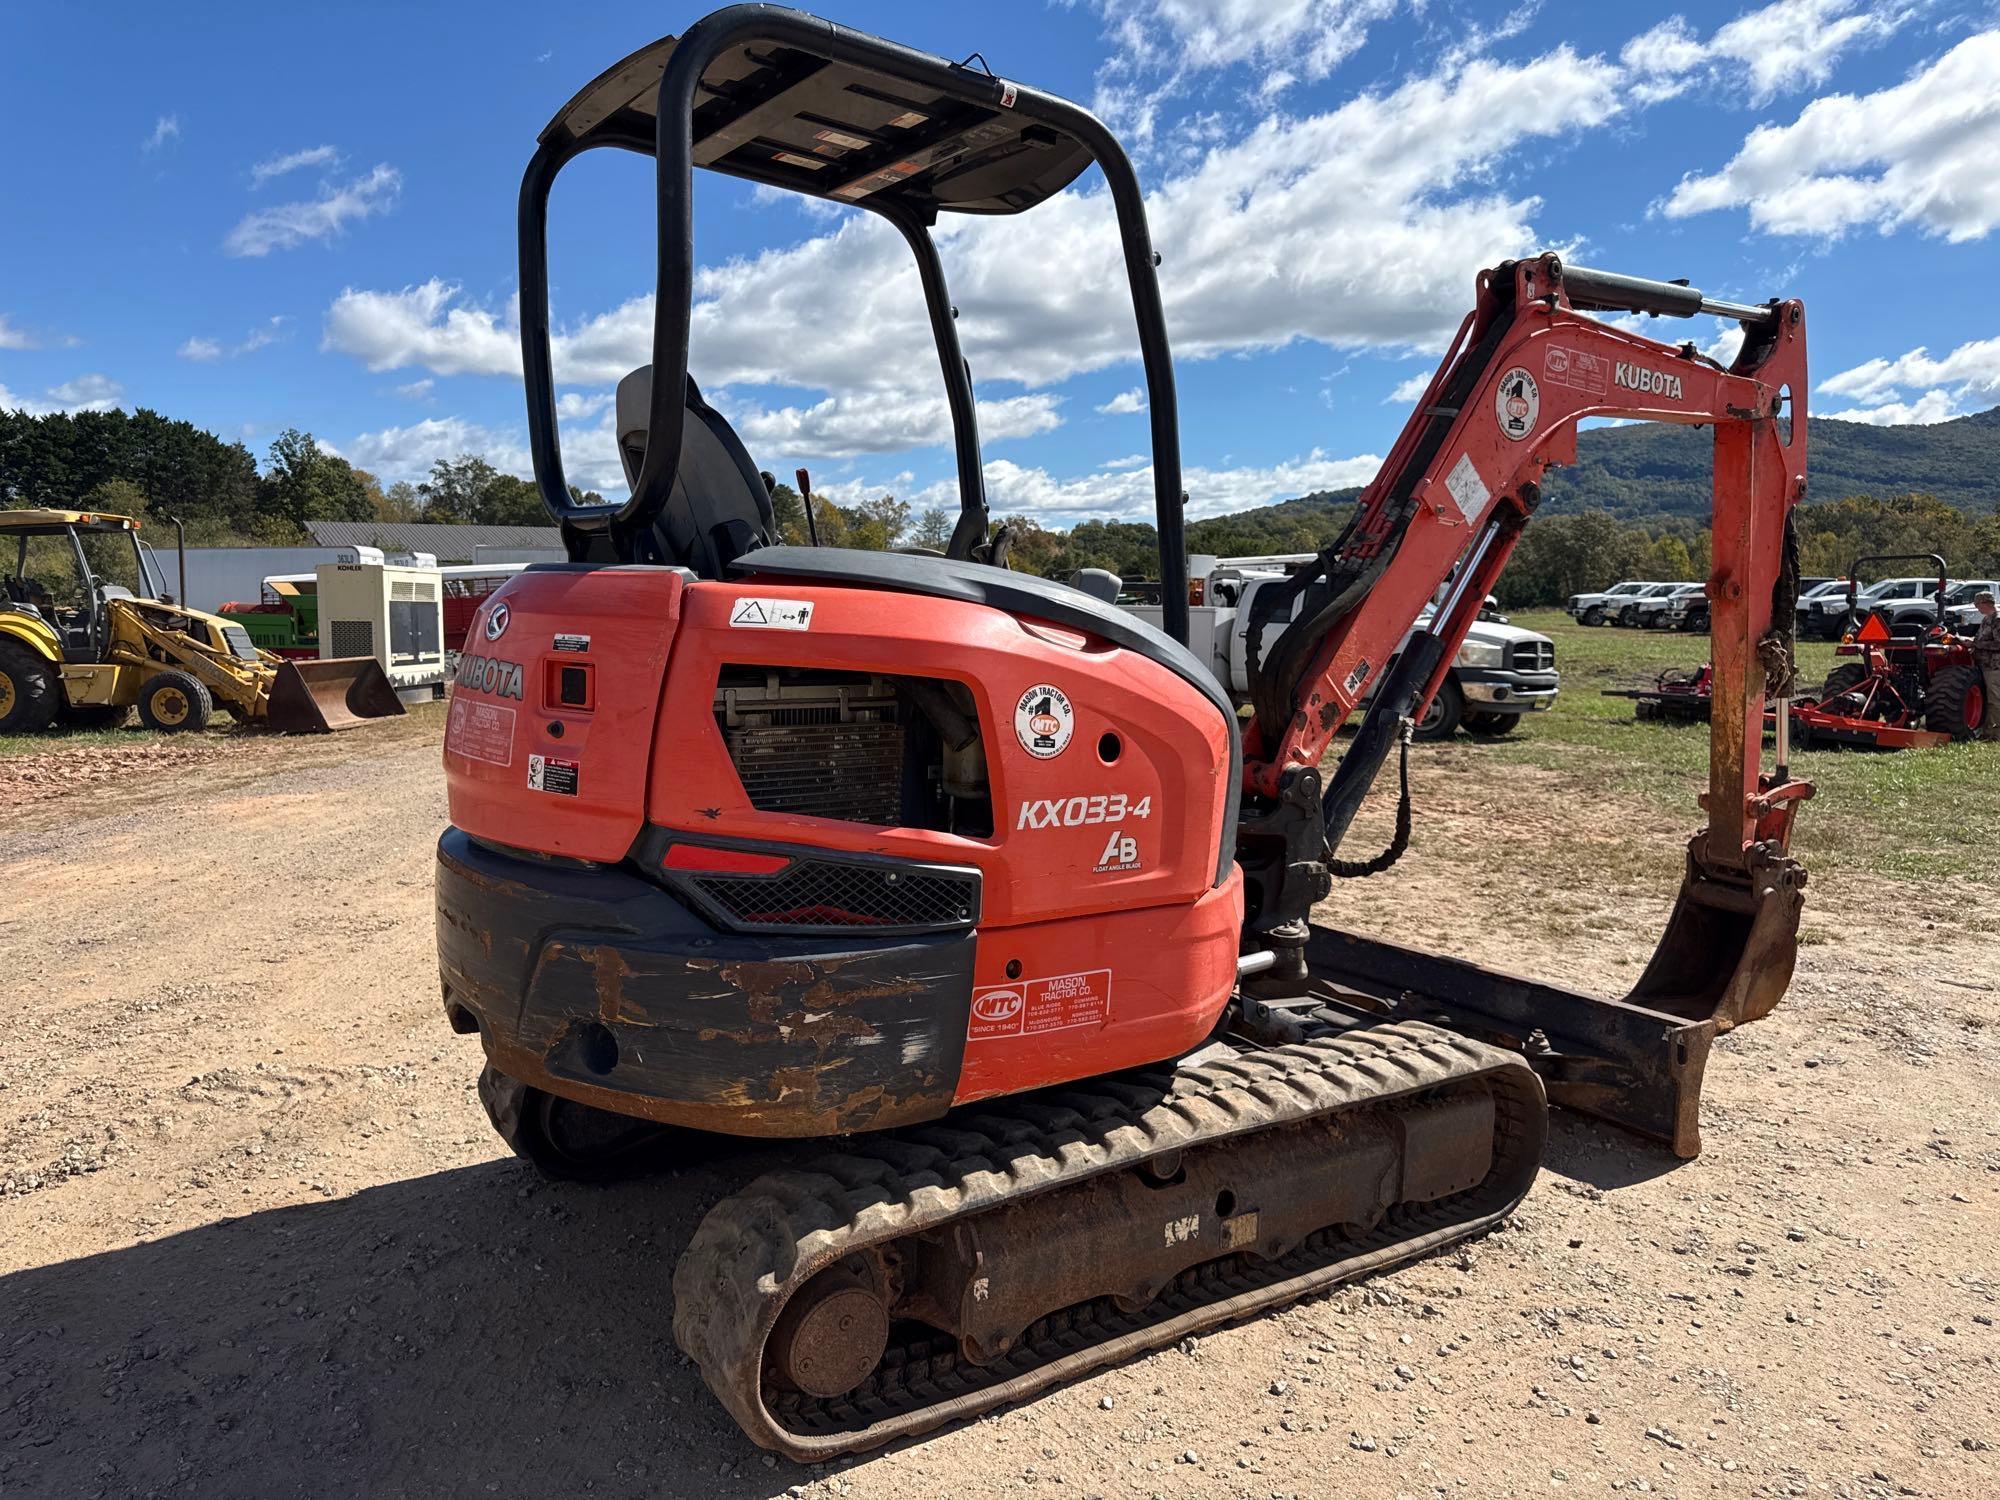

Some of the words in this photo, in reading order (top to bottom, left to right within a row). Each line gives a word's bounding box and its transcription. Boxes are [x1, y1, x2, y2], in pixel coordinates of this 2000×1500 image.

[1500, 371, 1514, 393] MASON
[1515, 370, 1534, 388] TRACTOR
[1614, 361, 1683, 400] KUBOTA
[455, 653, 524, 701] KUBOTA
[1019, 688, 1038, 712] MASON
[1039, 687, 1065, 705] TRACTOR
[1062, 703, 1071, 717] CO.
[1033, 718, 1058, 732] MTC
[1016, 793, 1151, 830] KX033-4
[1098, 830, 1138, 865] AB
[1040, 988, 1077, 1002] TRACTOR
[1079, 986, 1092, 995] CO.
[1048, 976, 1086, 991] MASON
[981, 996, 1018, 1015] MTC
